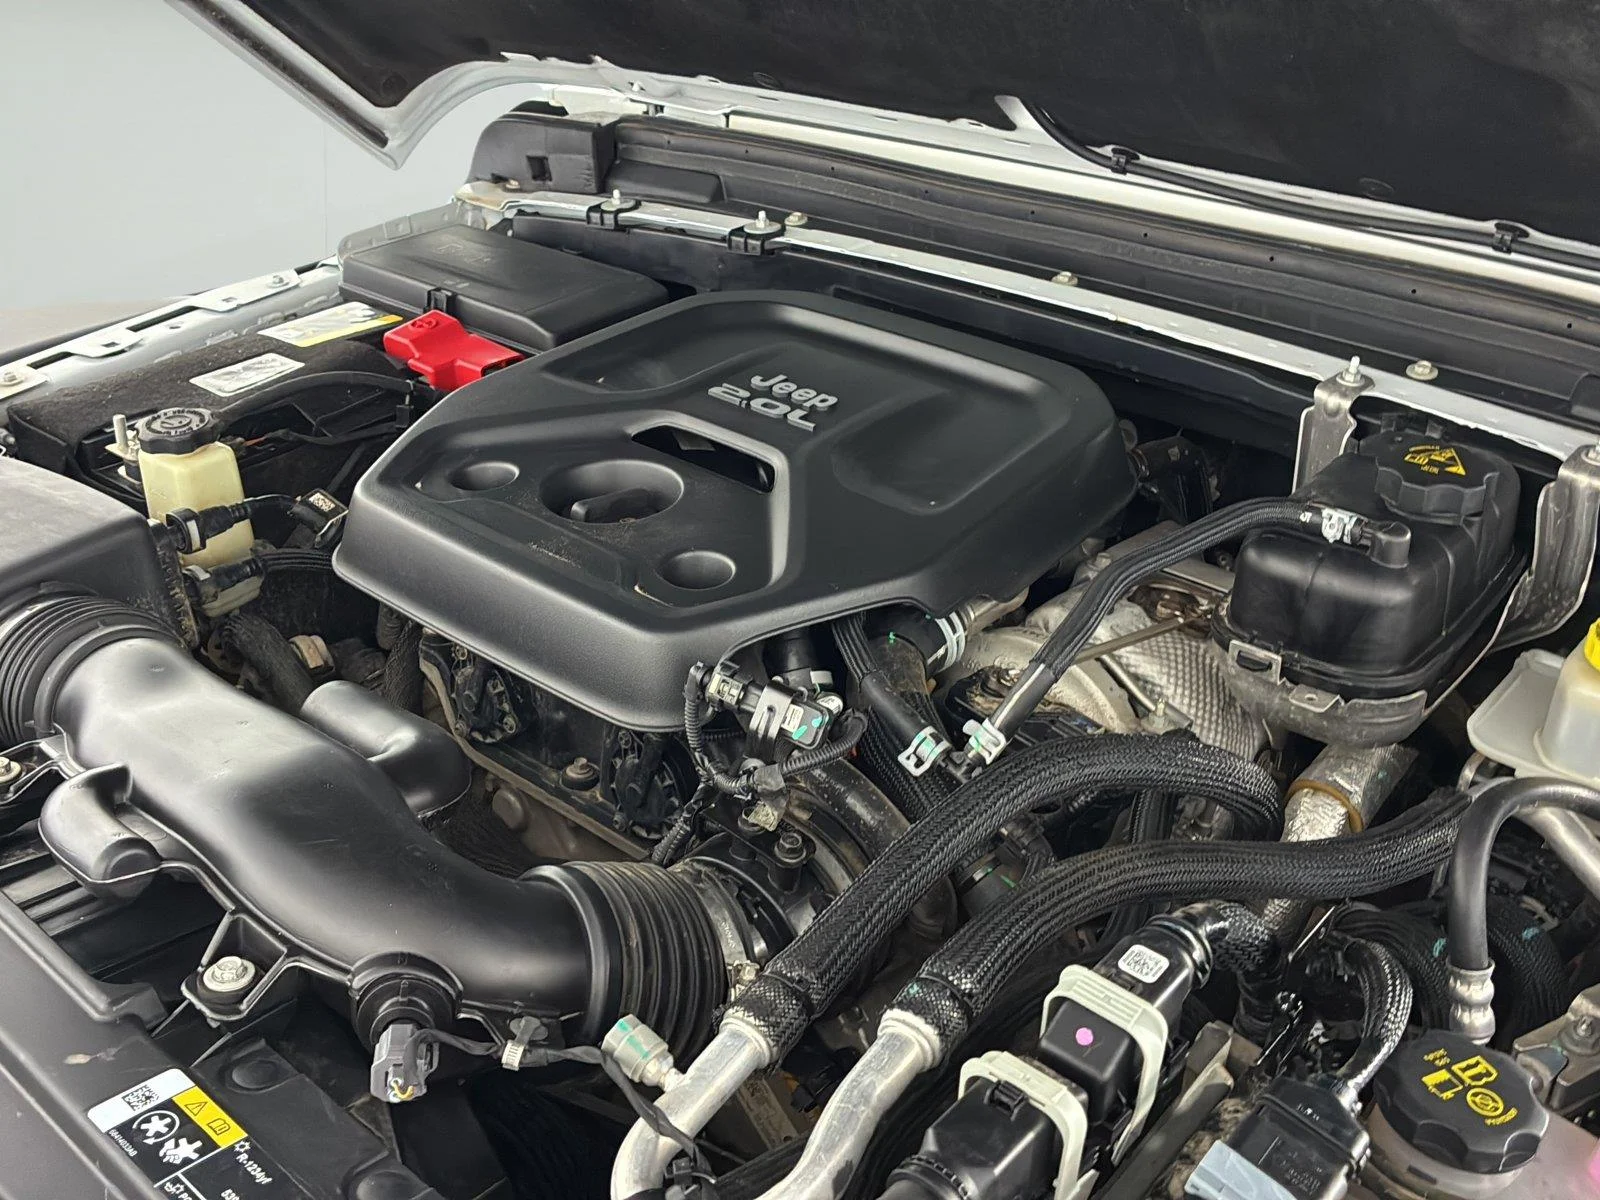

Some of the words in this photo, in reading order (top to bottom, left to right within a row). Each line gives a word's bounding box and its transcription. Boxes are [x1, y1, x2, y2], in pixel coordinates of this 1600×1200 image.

[707, 382, 816, 432] 2.0L
[751, 374, 838, 411] Jeep
[236, 1153, 273, 1185] R-1234yf
